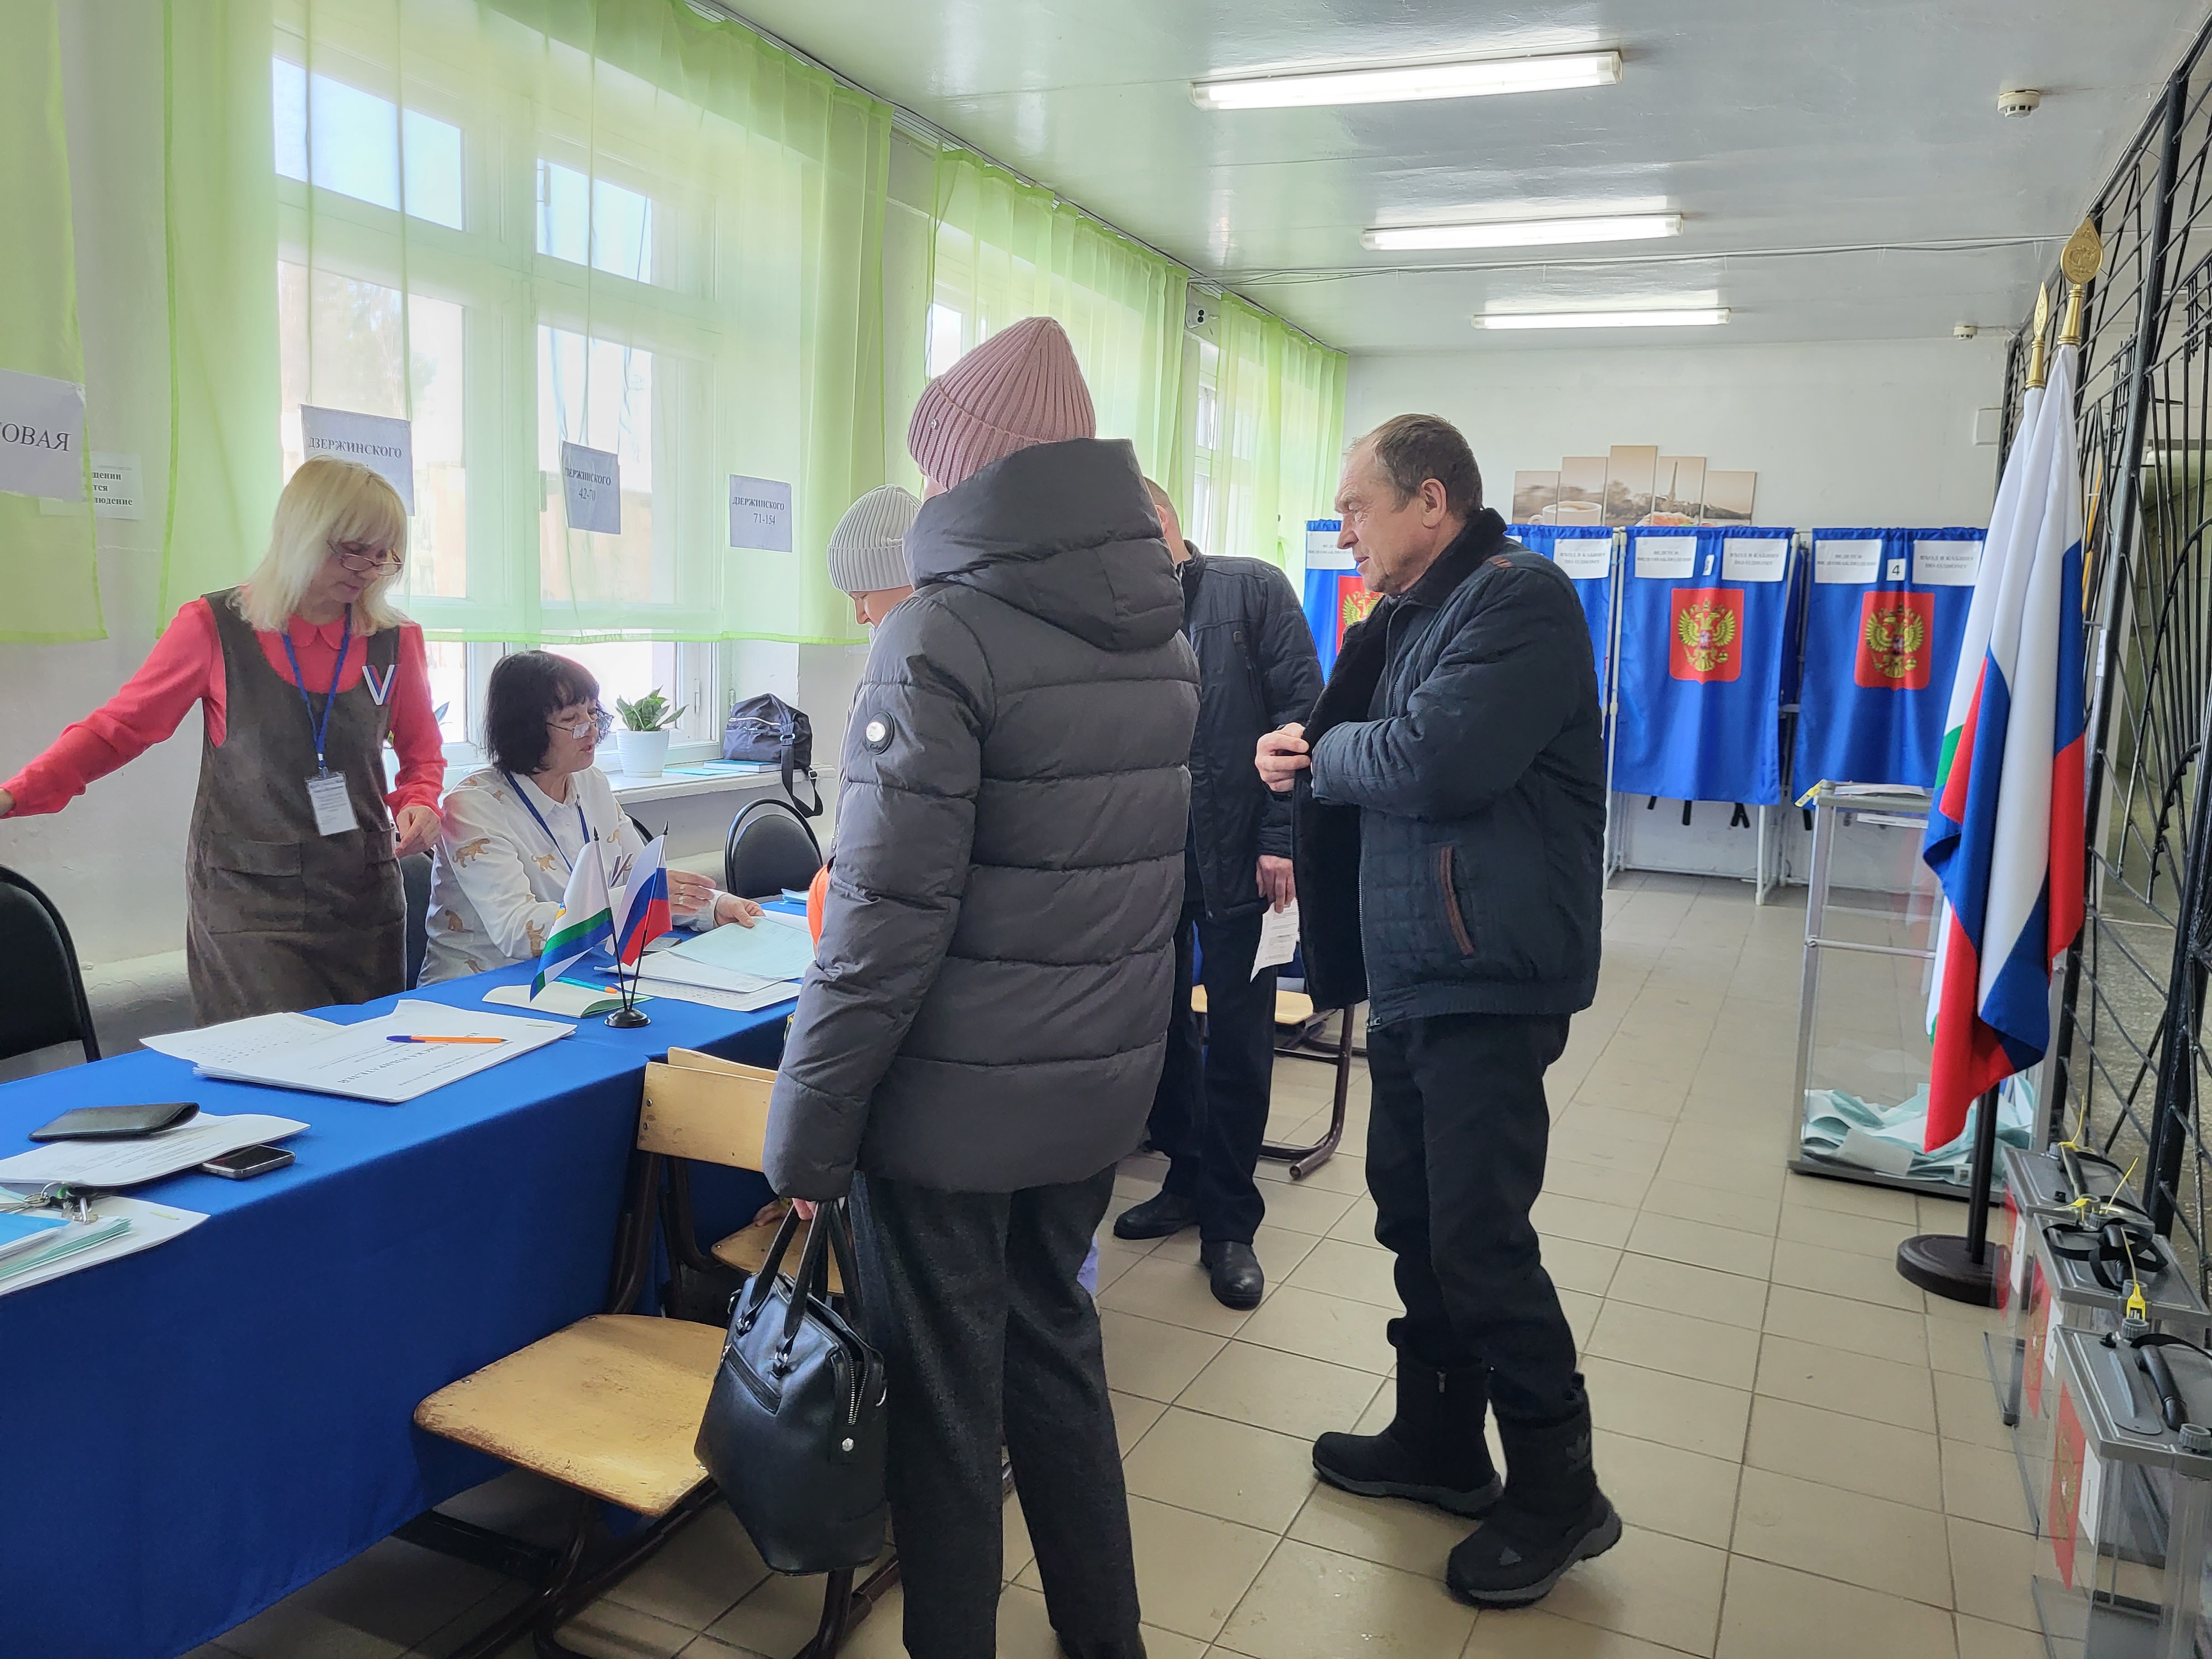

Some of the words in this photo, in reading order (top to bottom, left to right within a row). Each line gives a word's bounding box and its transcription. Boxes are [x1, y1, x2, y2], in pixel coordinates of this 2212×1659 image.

[0, 422, 71, 452] ОВАЯ
[309, 437, 402, 459] ДЗЕРЖИНСКОГО
[92, 472, 122, 481] щении
[578, 486, 596, 502] 42-70
[95, 497, 133, 505] людение
[732, 497, 785, 510] ДЗЕРЖИНСКОГО
[753, 513, 775, 525] 71-154
[1892, 565, 1900, 575] 4
